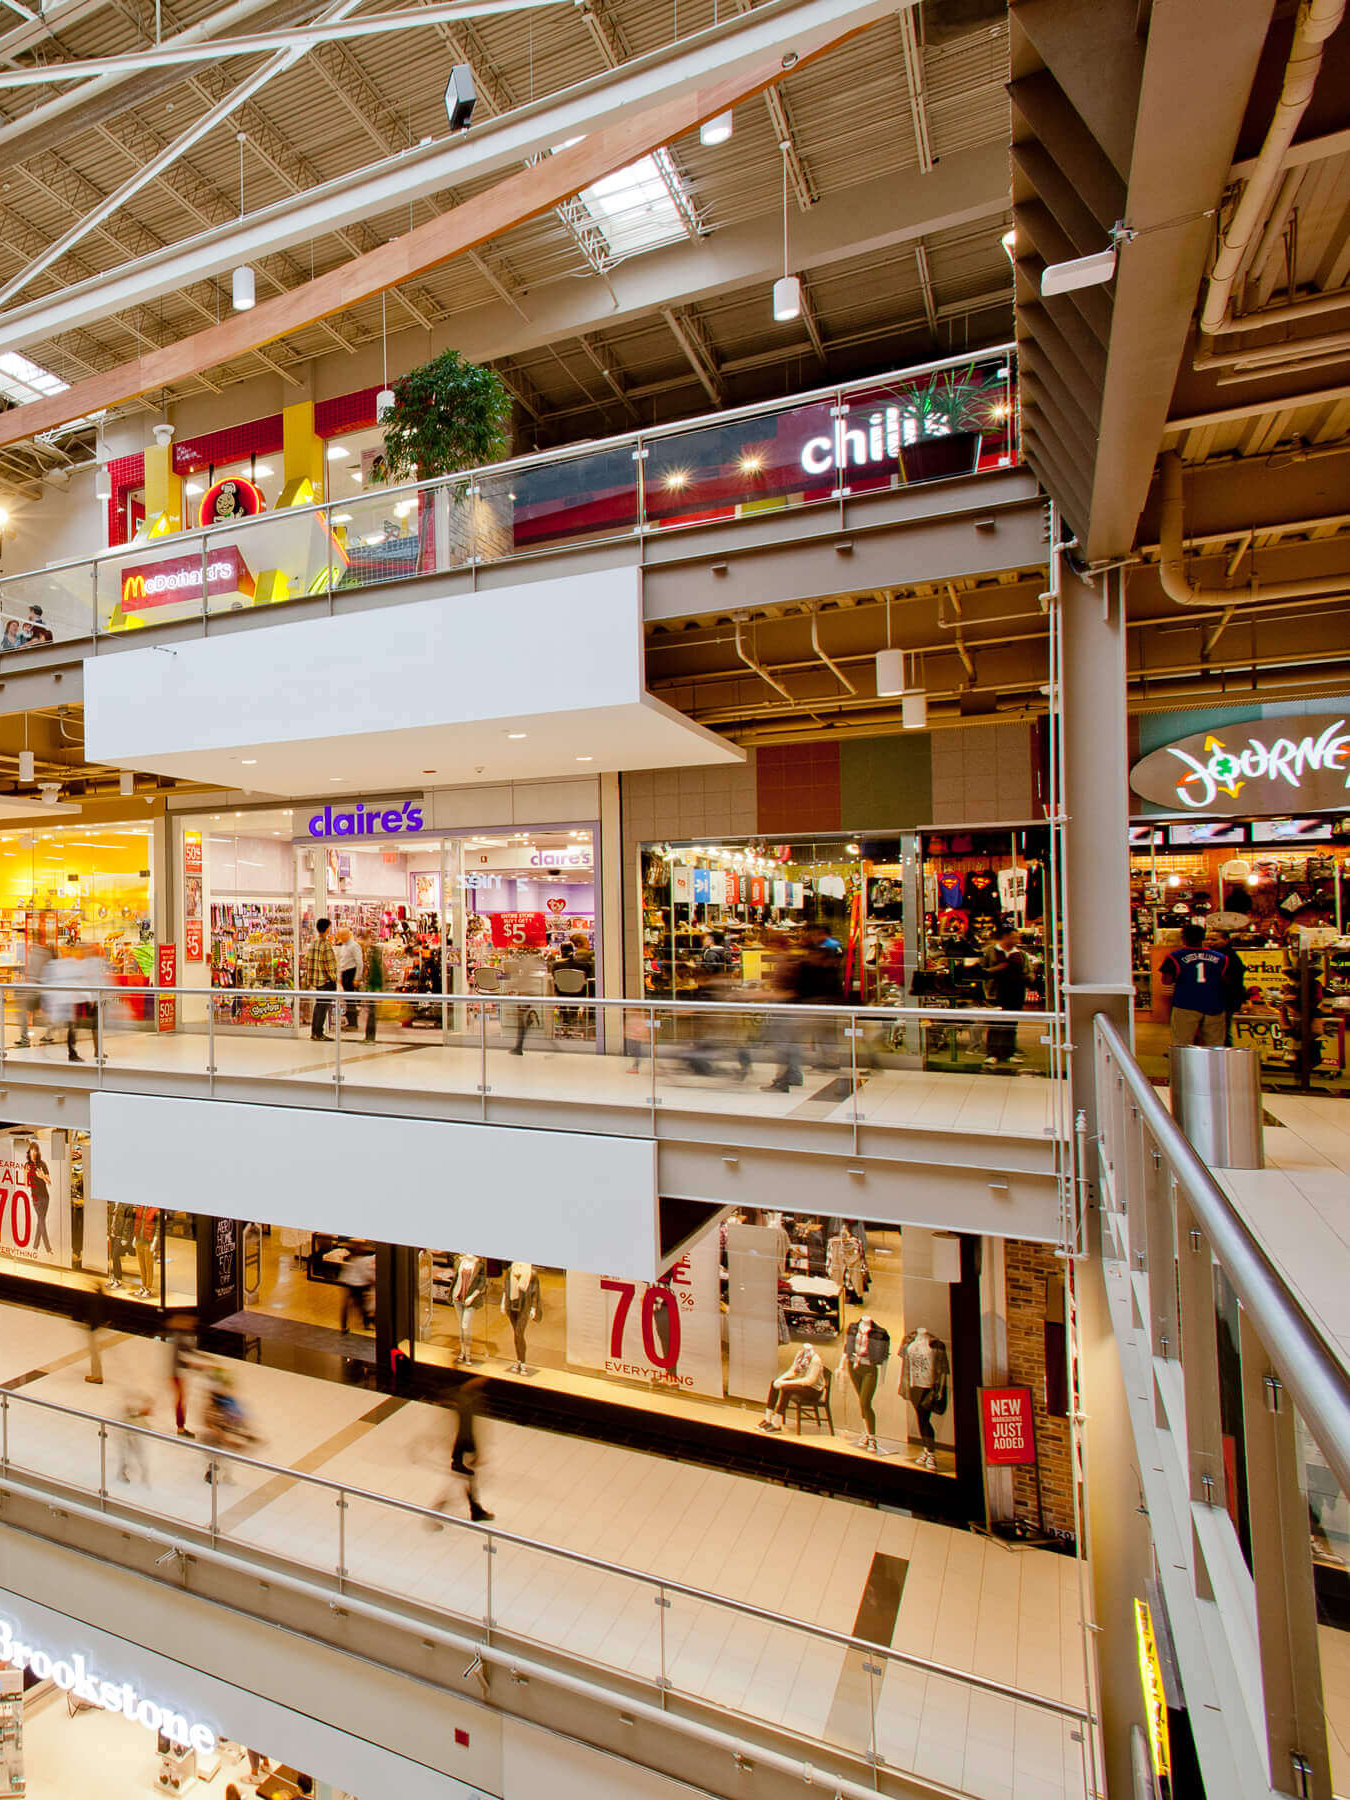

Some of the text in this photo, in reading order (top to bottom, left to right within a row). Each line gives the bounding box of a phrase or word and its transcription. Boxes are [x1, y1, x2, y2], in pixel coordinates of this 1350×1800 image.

[124, 562, 233, 600] McDonald's
[1167, 720, 1350, 808] JOURNE
[309, 801, 423, 837] claire's
[530, 851, 591, 866] claire's
[503, 923, 526, 944] $5
[187, 935, 199, 956] $5
[161, 961, 173, 981] $5
[1196, 961, 1207, 984] 1
[600, 1279, 681, 1369] 70
[605, 1360, 694, 1387] EVERYTHING
[990, 1398, 1021, 1417] NEW
[993, 1422, 1022, 1438] JUST
[993, 1437, 1025, 1450] ADDED
